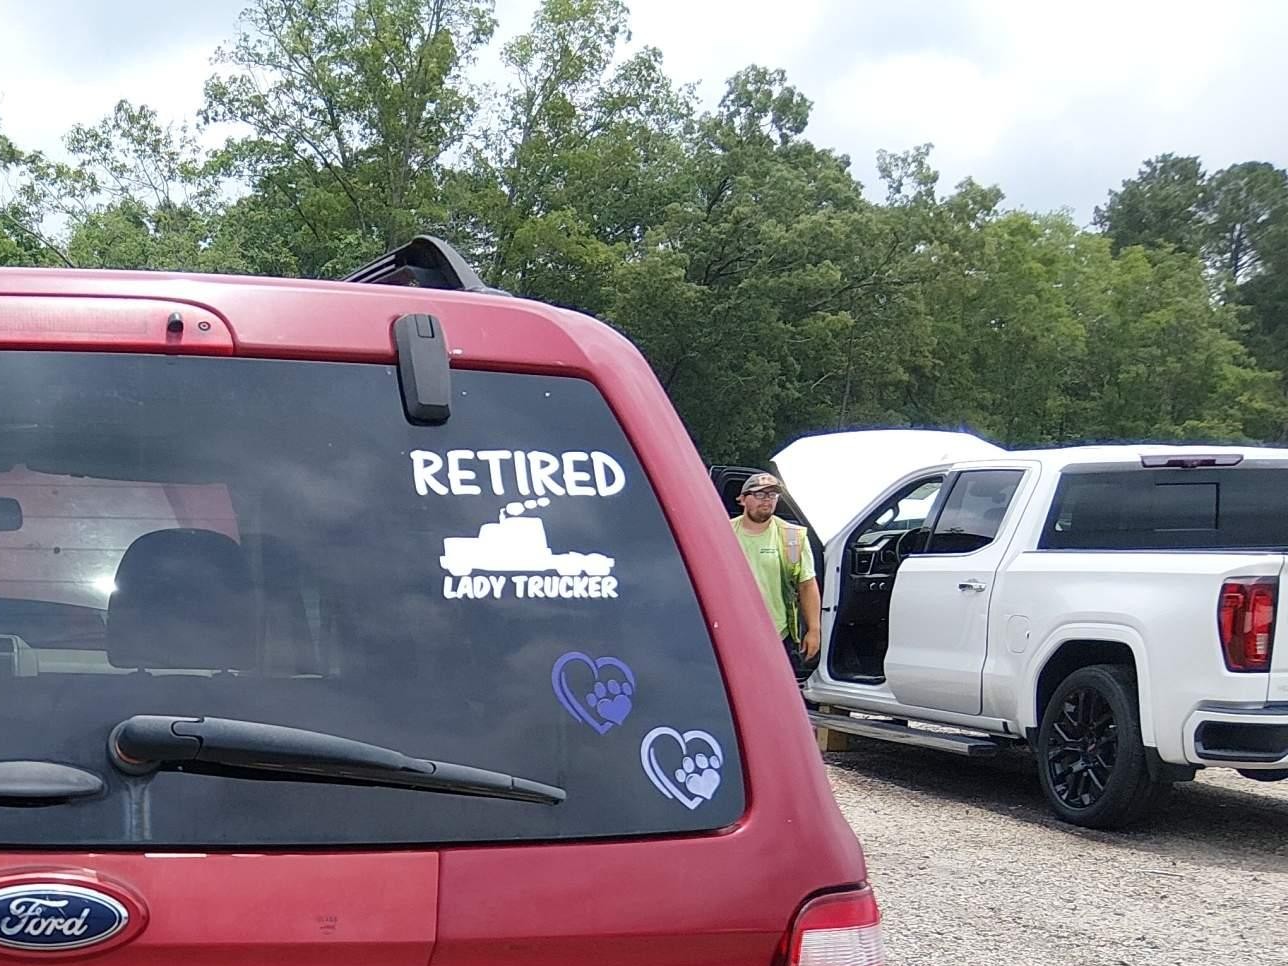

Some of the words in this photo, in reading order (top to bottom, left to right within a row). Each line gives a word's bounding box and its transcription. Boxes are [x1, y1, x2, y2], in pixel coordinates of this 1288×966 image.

[410, 450, 626, 497] RETIRED
[443, 575, 506, 599] LADY
[512, 575, 619, 599] TRUCKER
[0, 897, 91, 936] Ford
